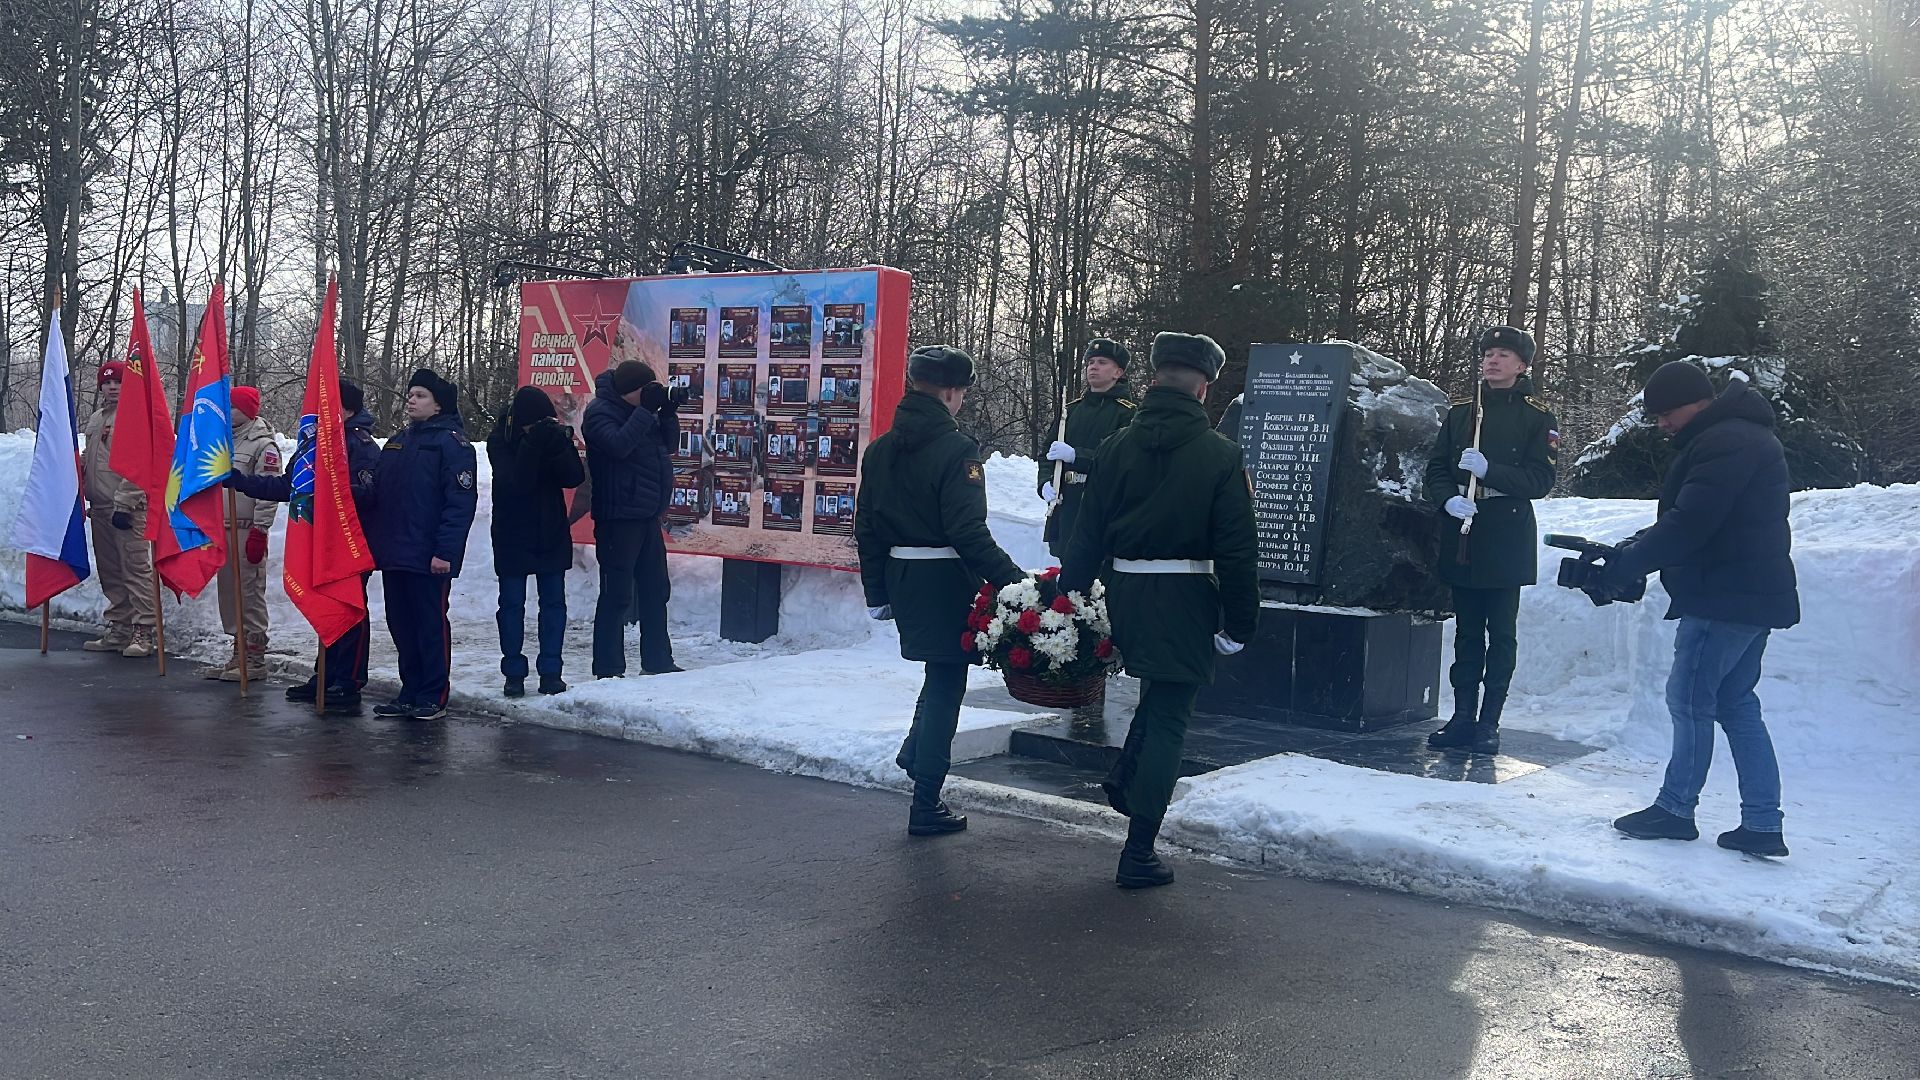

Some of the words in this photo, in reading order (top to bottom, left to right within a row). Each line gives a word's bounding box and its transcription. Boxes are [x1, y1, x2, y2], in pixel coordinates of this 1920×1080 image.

[531, 332, 577, 349] Вечная
[530, 352, 577, 367] память
[338, 509, 361, 560] ВЕТЕРАНОВ
